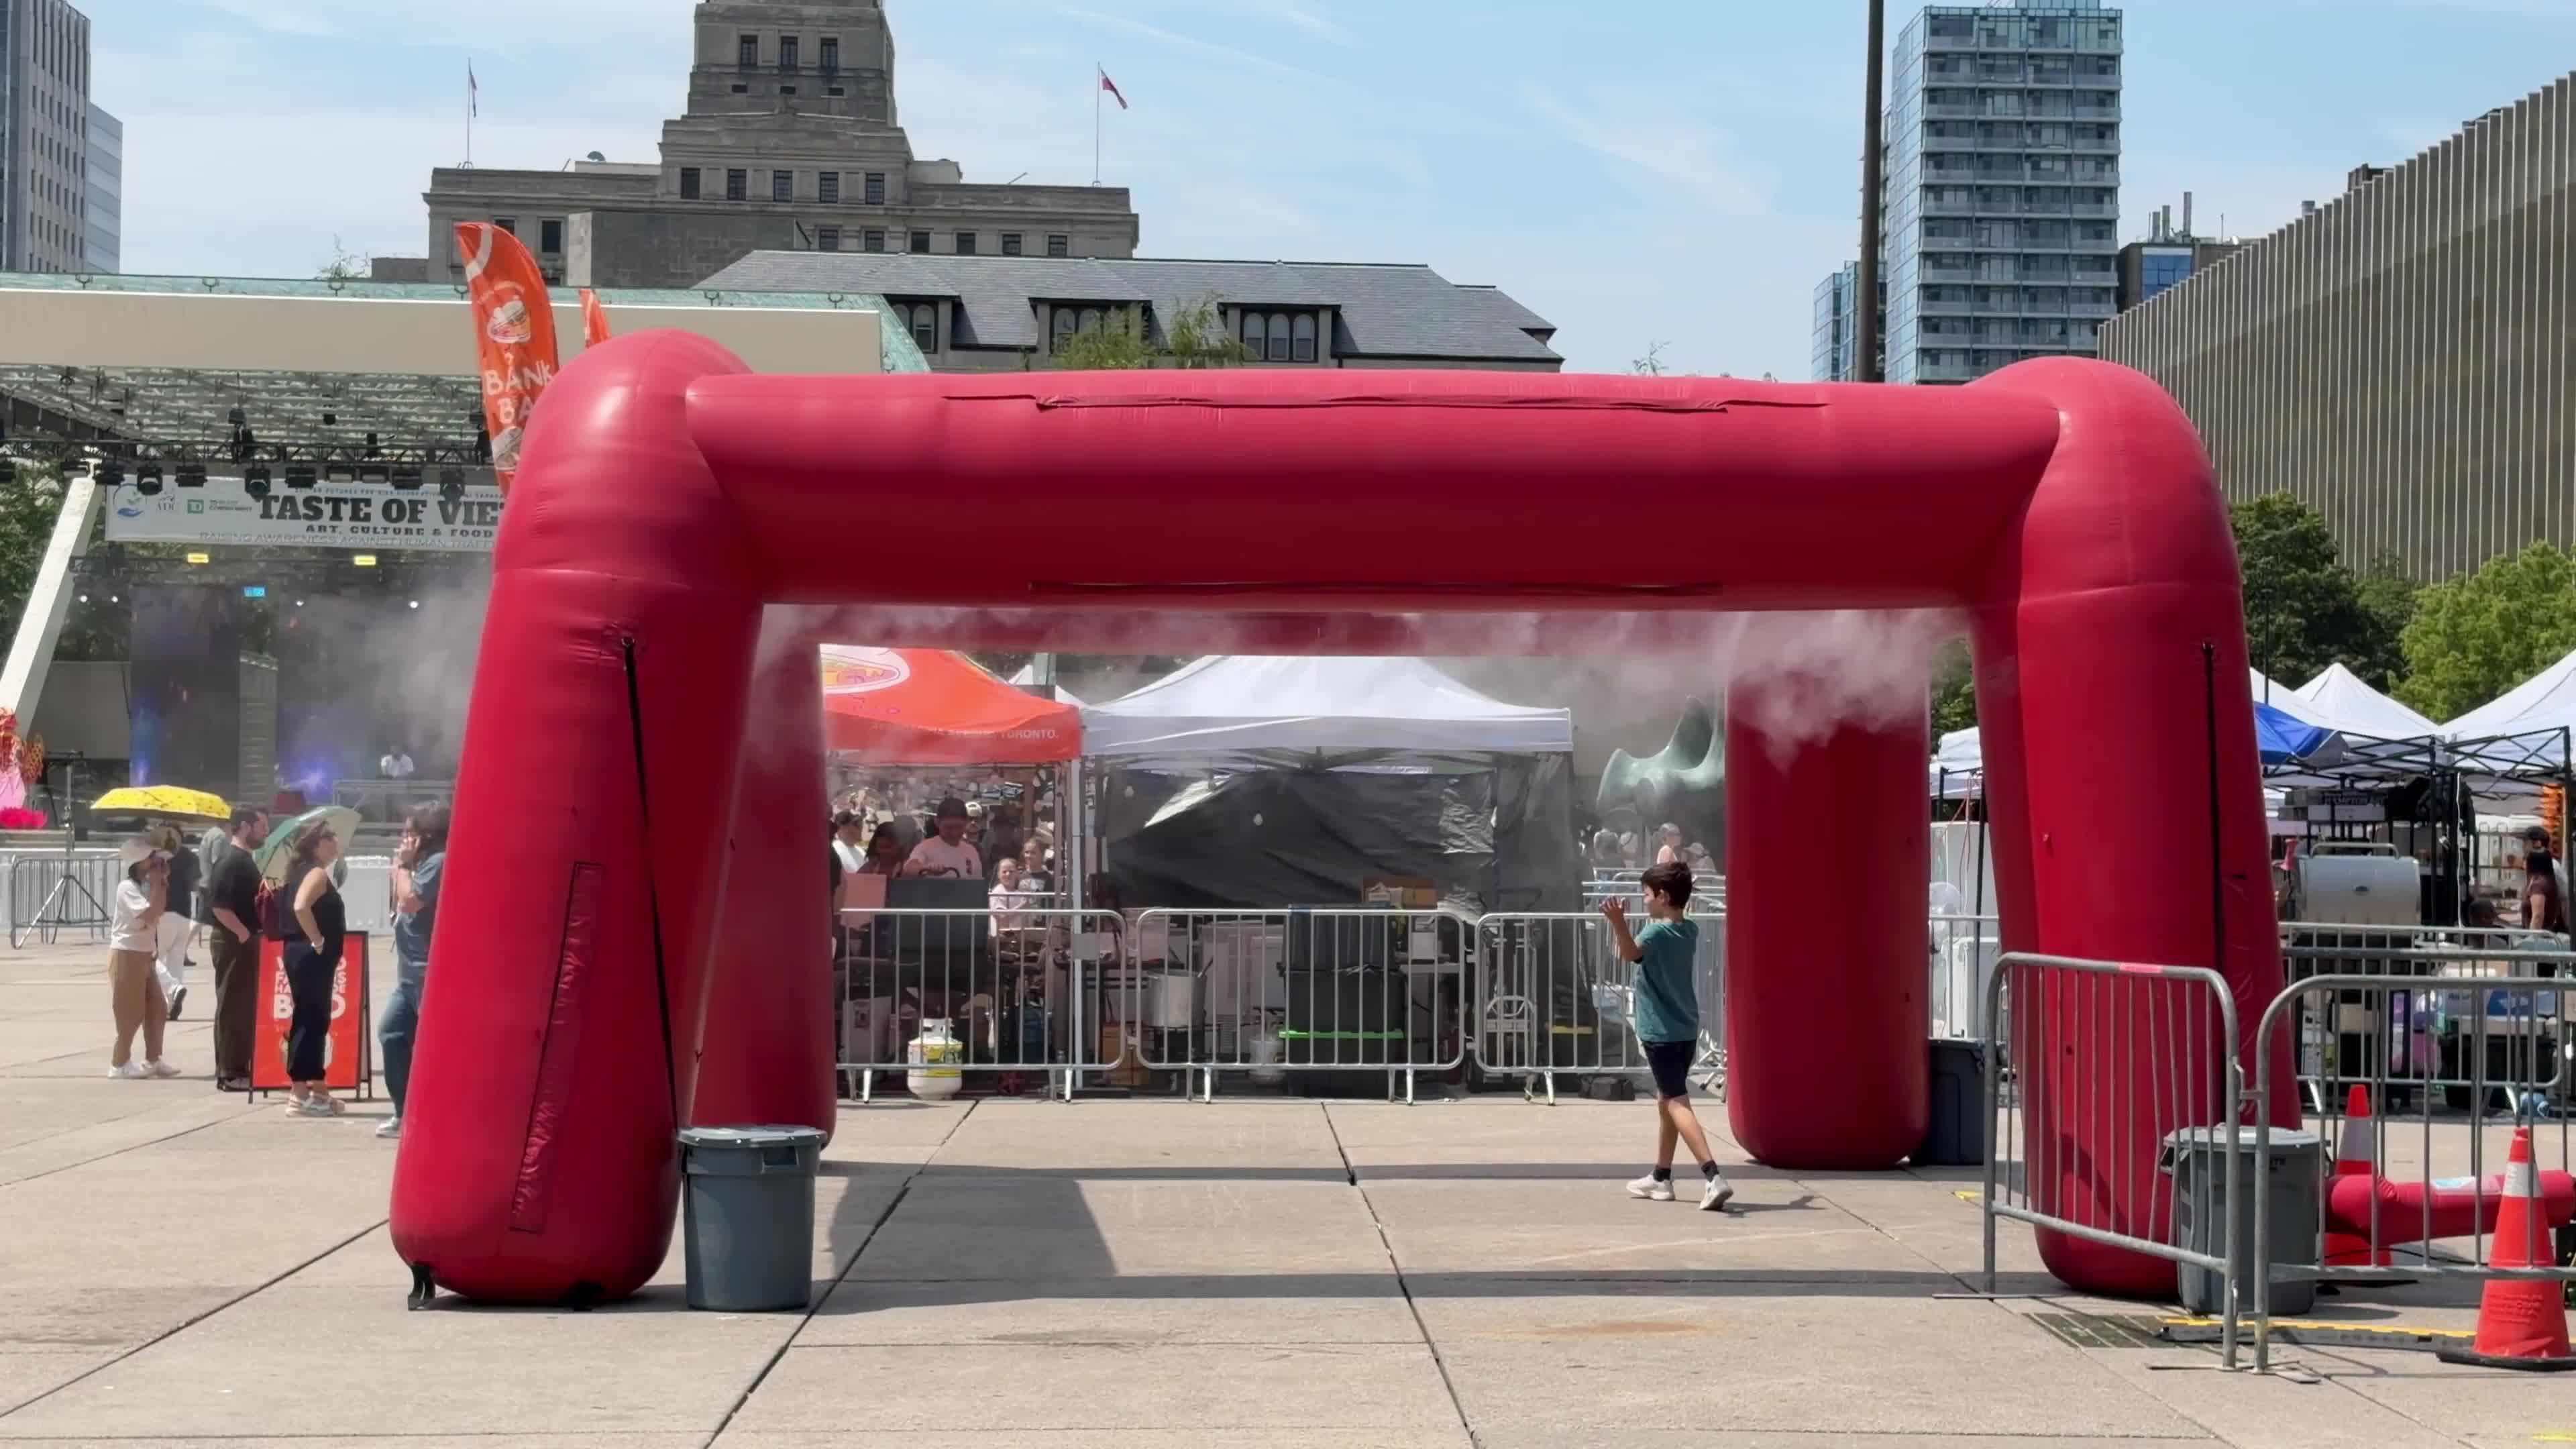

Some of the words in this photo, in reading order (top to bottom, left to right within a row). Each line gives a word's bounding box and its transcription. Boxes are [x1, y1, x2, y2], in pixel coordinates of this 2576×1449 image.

[259, 494, 372, 523] TASTE
[382, 498, 427, 524] OF
[437, 500, 504, 526] VIE
[350, 525, 425, 536] CULTURE
[451, 529, 494, 537] FOOD
